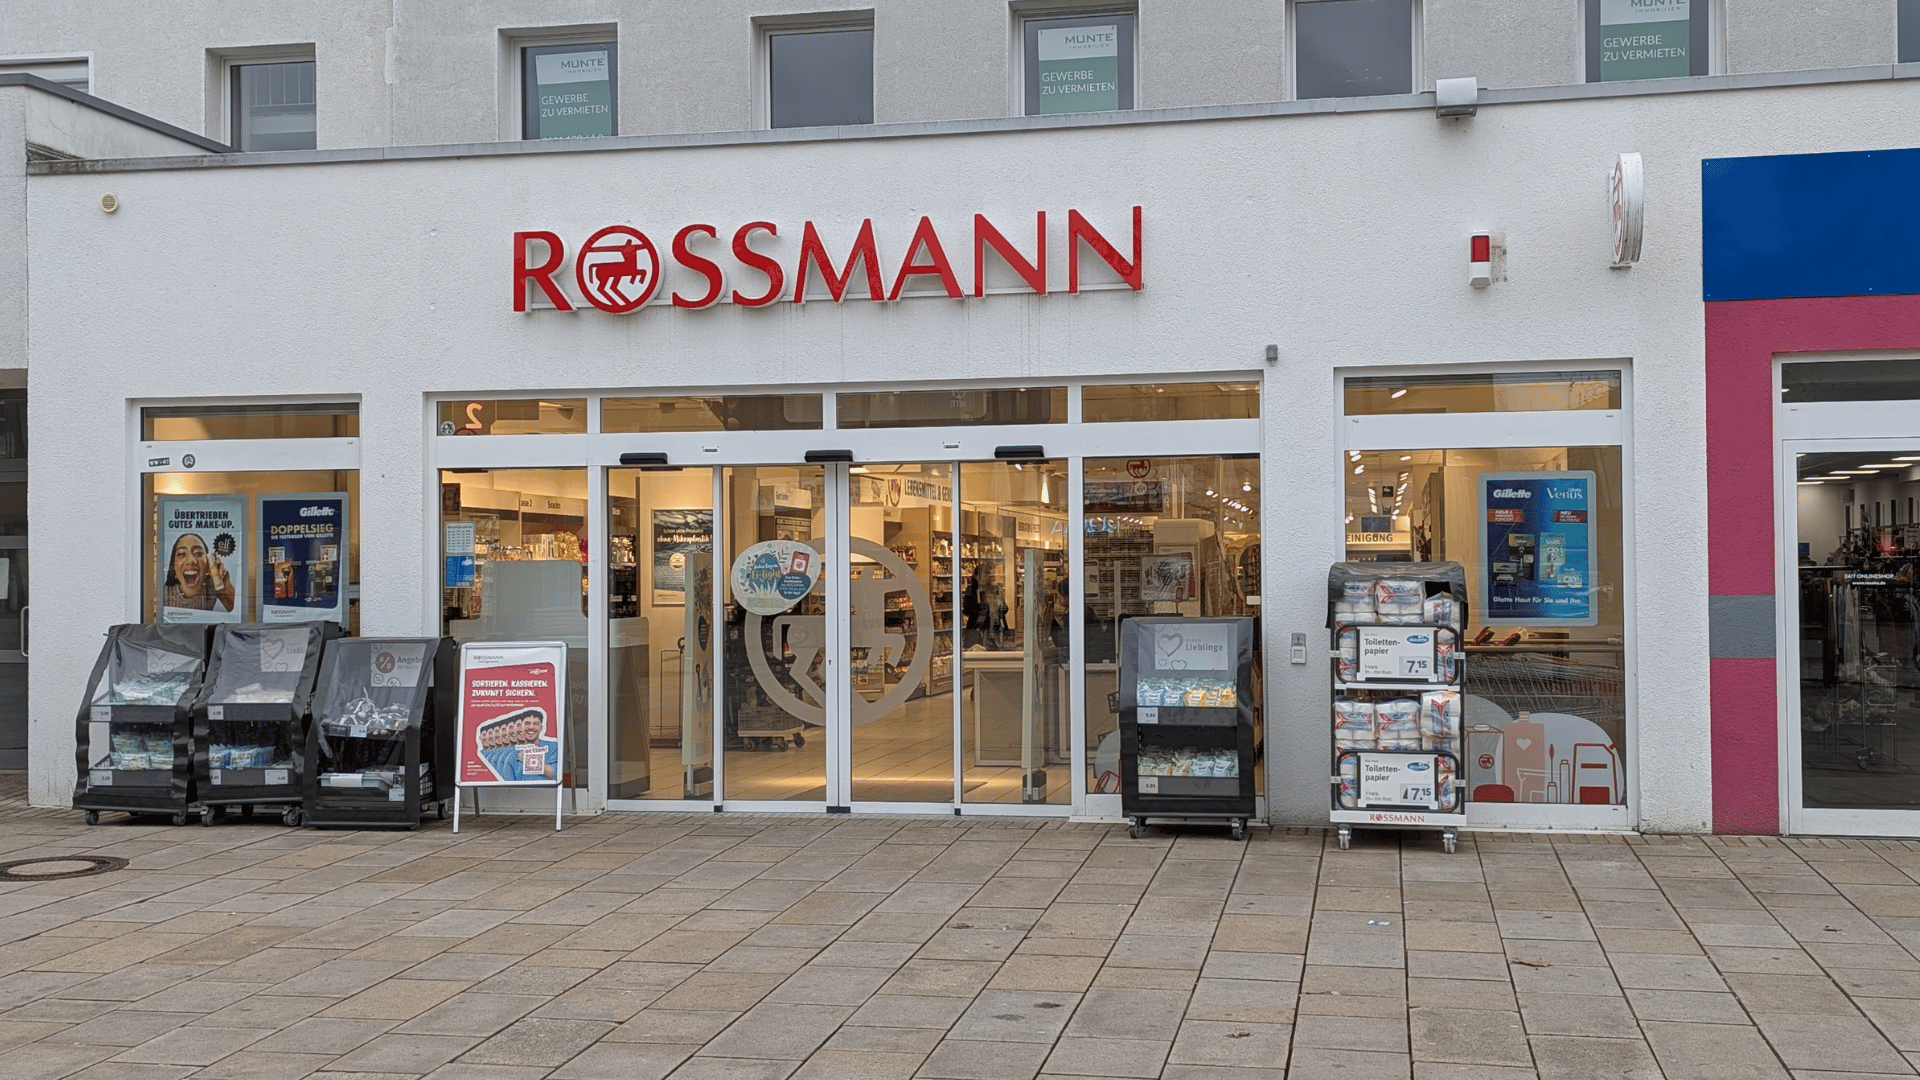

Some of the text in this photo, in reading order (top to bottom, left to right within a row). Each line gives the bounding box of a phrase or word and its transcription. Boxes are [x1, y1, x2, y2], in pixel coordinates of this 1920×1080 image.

[1064, 33, 1114, 44] MUNTE
[1603, 34, 1662, 48] GEWERBE
[1603, 47, 1686, 62] ZU VERMIETEN
[561, 58, 605, 70] MUNTE
[1041, 70, 1094, 82] GEWERBE
[1042, 82, 1115, 95] ZU VERMIETEN
[541, 93, 589, 106] GEWERBE
[541, 104, 609, 118] ZU VERMIETEN
[513, 205, 1142, 314] ROSSMANN
[1492, 487, 1584, 500] Gillette Venus
[174, 508, 229, 520] ÜBERTRIEBEN
[299, 506, 335, 517] Gillette
[168, 520, 235, 529] GUTES MAKE-UP.
[270, 523, 334, 535] DOPPELSIEG
[1185, 643, 1224, 653] Lieblinge
[1364, 638, 1401, 646] Toiletten-
[1364, 647, 1389, 656] papier
[1406, 660, 1427, 674] 7.15
[471, 689, 503, 697] ZUKUNFT
[1364, 764, 1402, 773] Toiletten-
[1365, 773, 1390, 783] papier
[1410, 787, 1432, 801] 7.15
[1369, 813, 1425, 822] ROSSMANN
